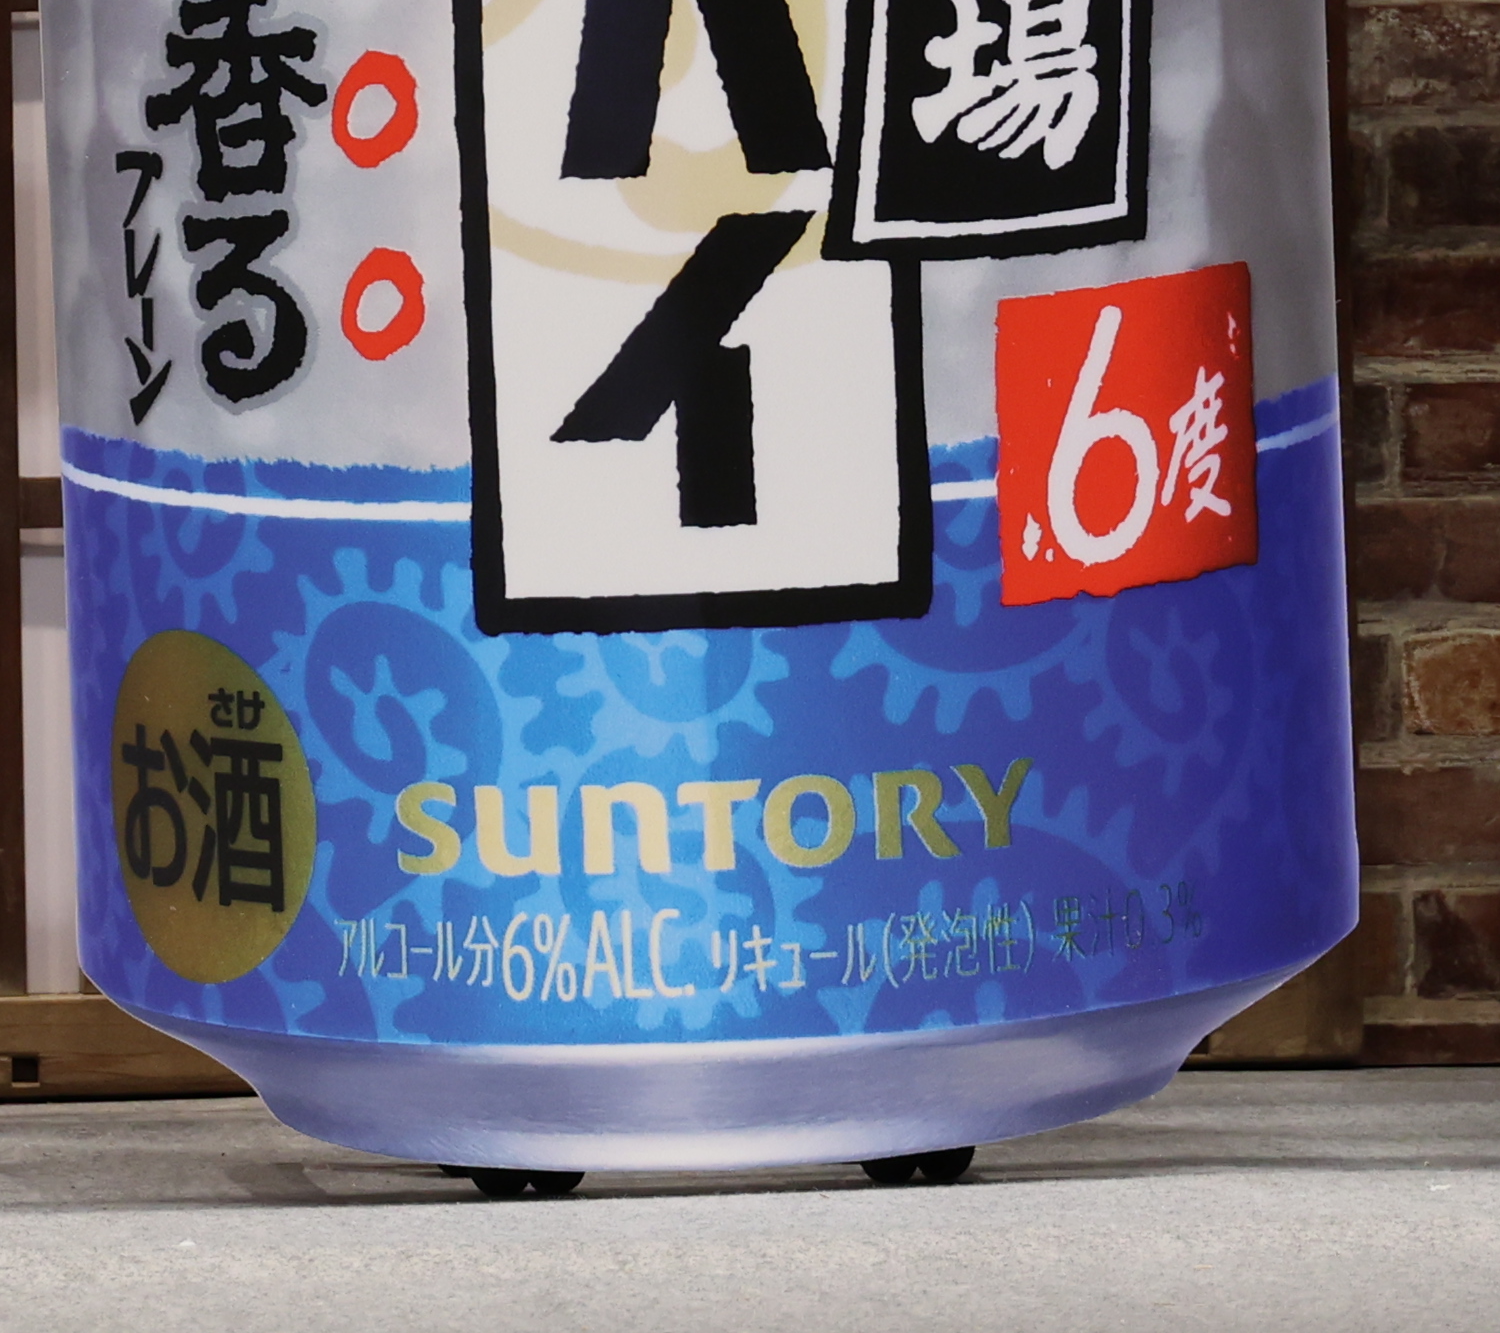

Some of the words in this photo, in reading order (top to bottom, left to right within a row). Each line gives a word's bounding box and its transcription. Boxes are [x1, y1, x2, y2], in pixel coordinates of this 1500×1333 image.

[1047, 305, 1235, 567] 6度
[208, 688, 266, 730] さけ
[121, 723, 288, 918] お酒
[395, 756, 1034, 876] SUNTORY
[711, 899, 1036, 993] リキュール(発泡性)
